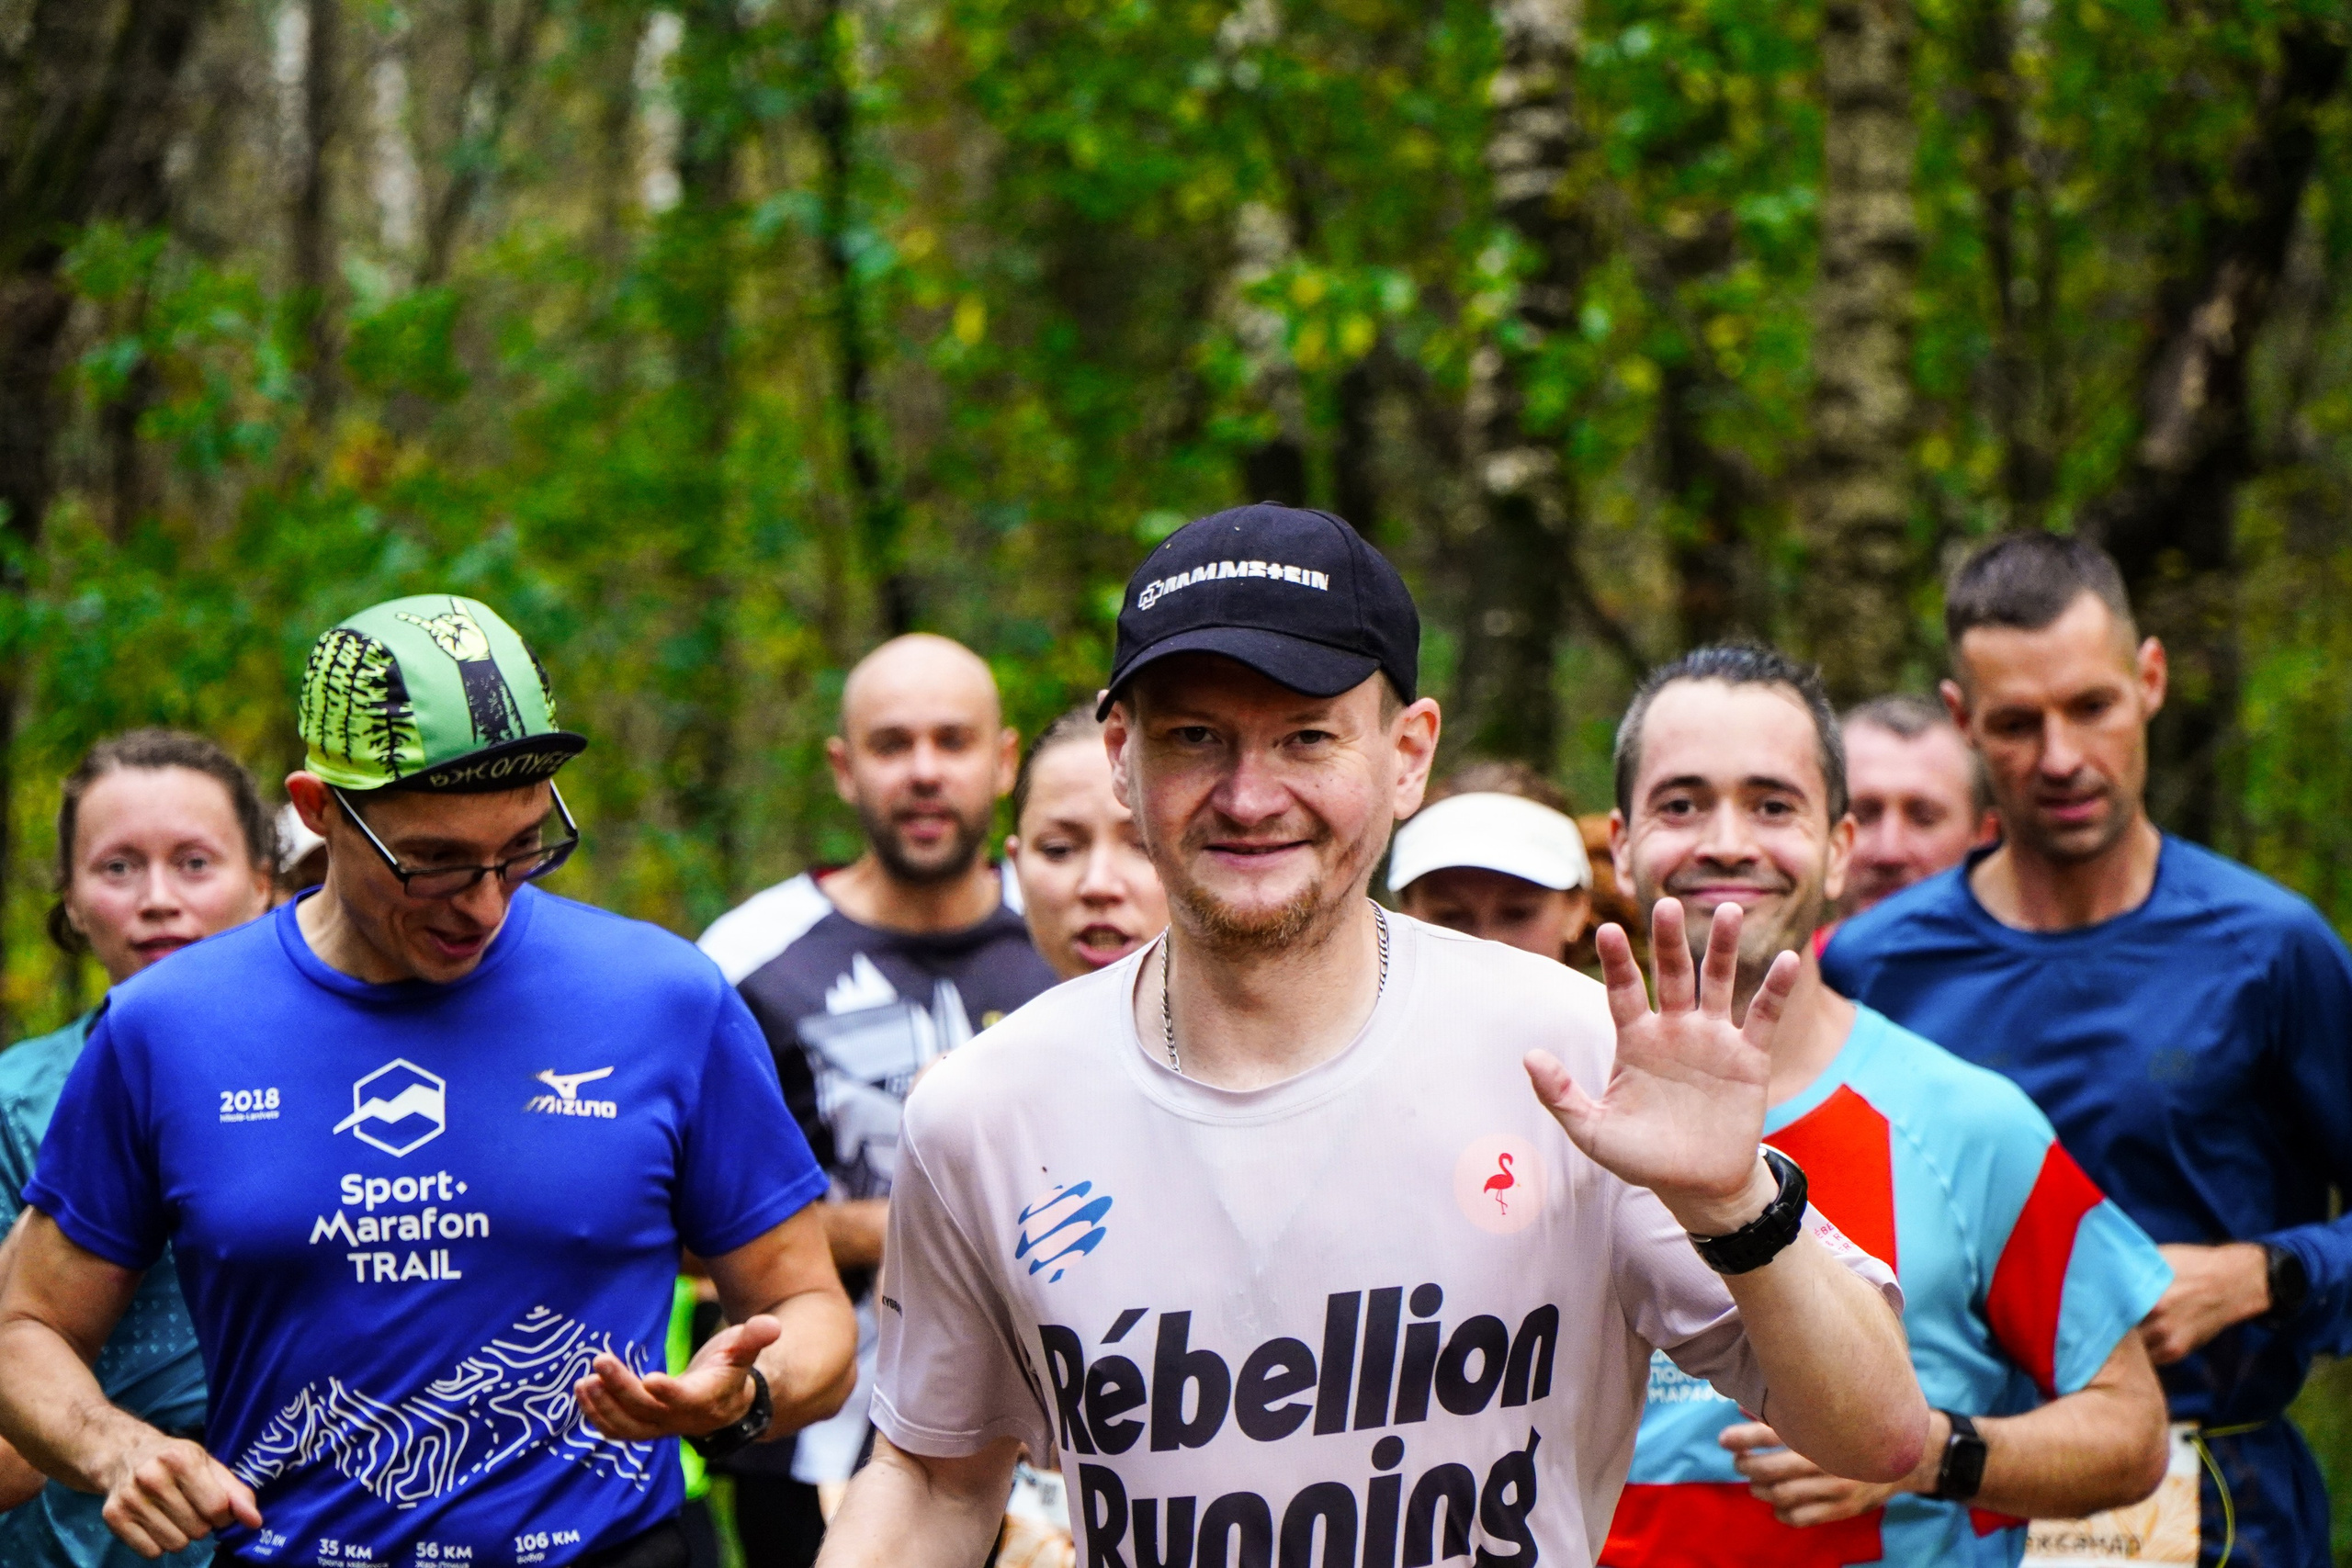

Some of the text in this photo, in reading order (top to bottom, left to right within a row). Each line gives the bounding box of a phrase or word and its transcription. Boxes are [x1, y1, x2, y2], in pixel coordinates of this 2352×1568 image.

[1161, 560, 1329, 595] RAMMSTEIN
[220, 1087, 280, 1112] 2018
[309, 1206, 490, 1247] Marafon
[346, 1249, 462, 1283] TRAIL
[1038, 1283, 1559, 1455] Rébellion
[1079, 1426, 1541, 1568] Running
[319, 1539, 339, 1556] 35
[415, 1541, 439, 1559] 56
[514, 1531, 548, 1553] 106
